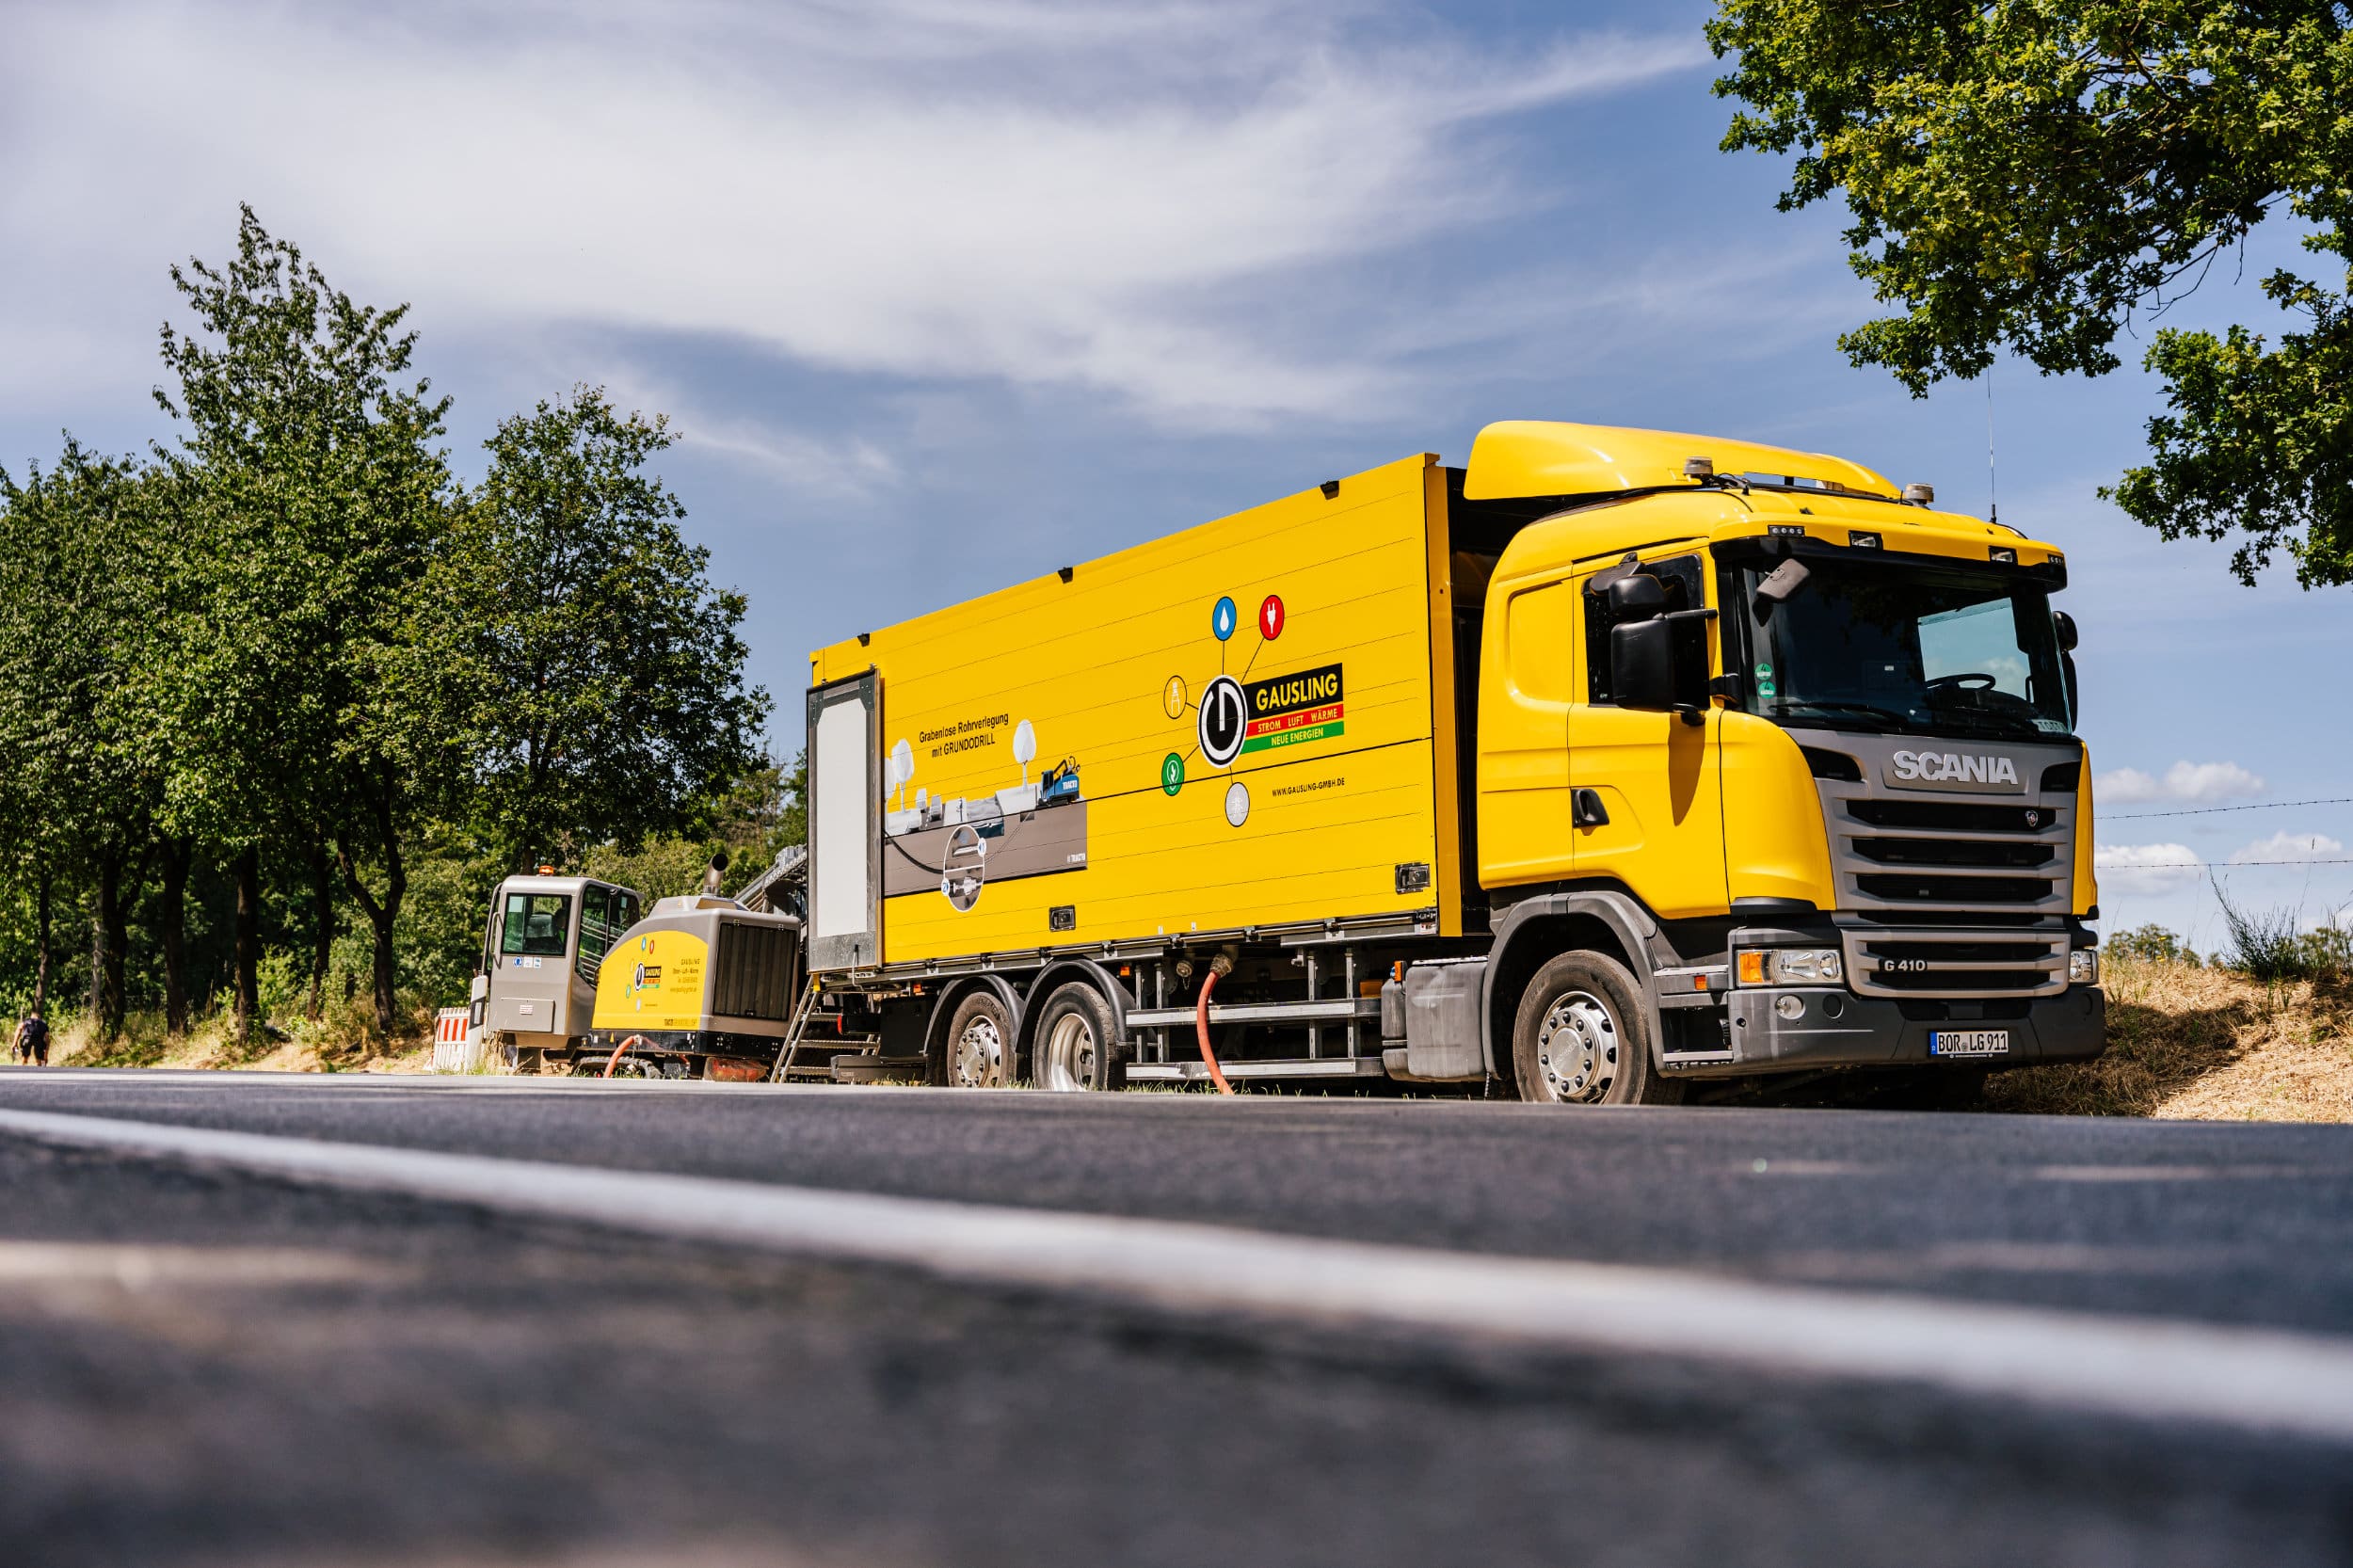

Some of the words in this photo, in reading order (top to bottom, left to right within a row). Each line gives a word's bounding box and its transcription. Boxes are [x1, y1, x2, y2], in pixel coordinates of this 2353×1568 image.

[1256, 673, 1337, 711] GAUSLING
[919, 727, 956, 743] Grabenlose
[957, 713, 1009, 734] Rohrverlegung
[1257, 720, 1281, 733] STROM
[1288, 714, 1305, 728] LUFT
[1310, 708, 1337, 722] WÄRME
[932, 746, 942, 758] mit
[943, 733, 995, 755] GRUNDODRILL
[1271, 736, 1289, 746] NEUE
[1289, 728, 1324, 742] ENERGIEN
[1893, 750, 2018, 785] SCANIA
[1272, 777, 1345, 797] WWW.GAUSLING-GMBH.DE
[1884, 960, 1895, 971] G
[1897, 960, 1926, 971] 410
[1938, 1034, 1961, 1052] BOR
[1969, 1033, 1985, 1051] LG
[1987, 1032, 2008, 1051] 911
